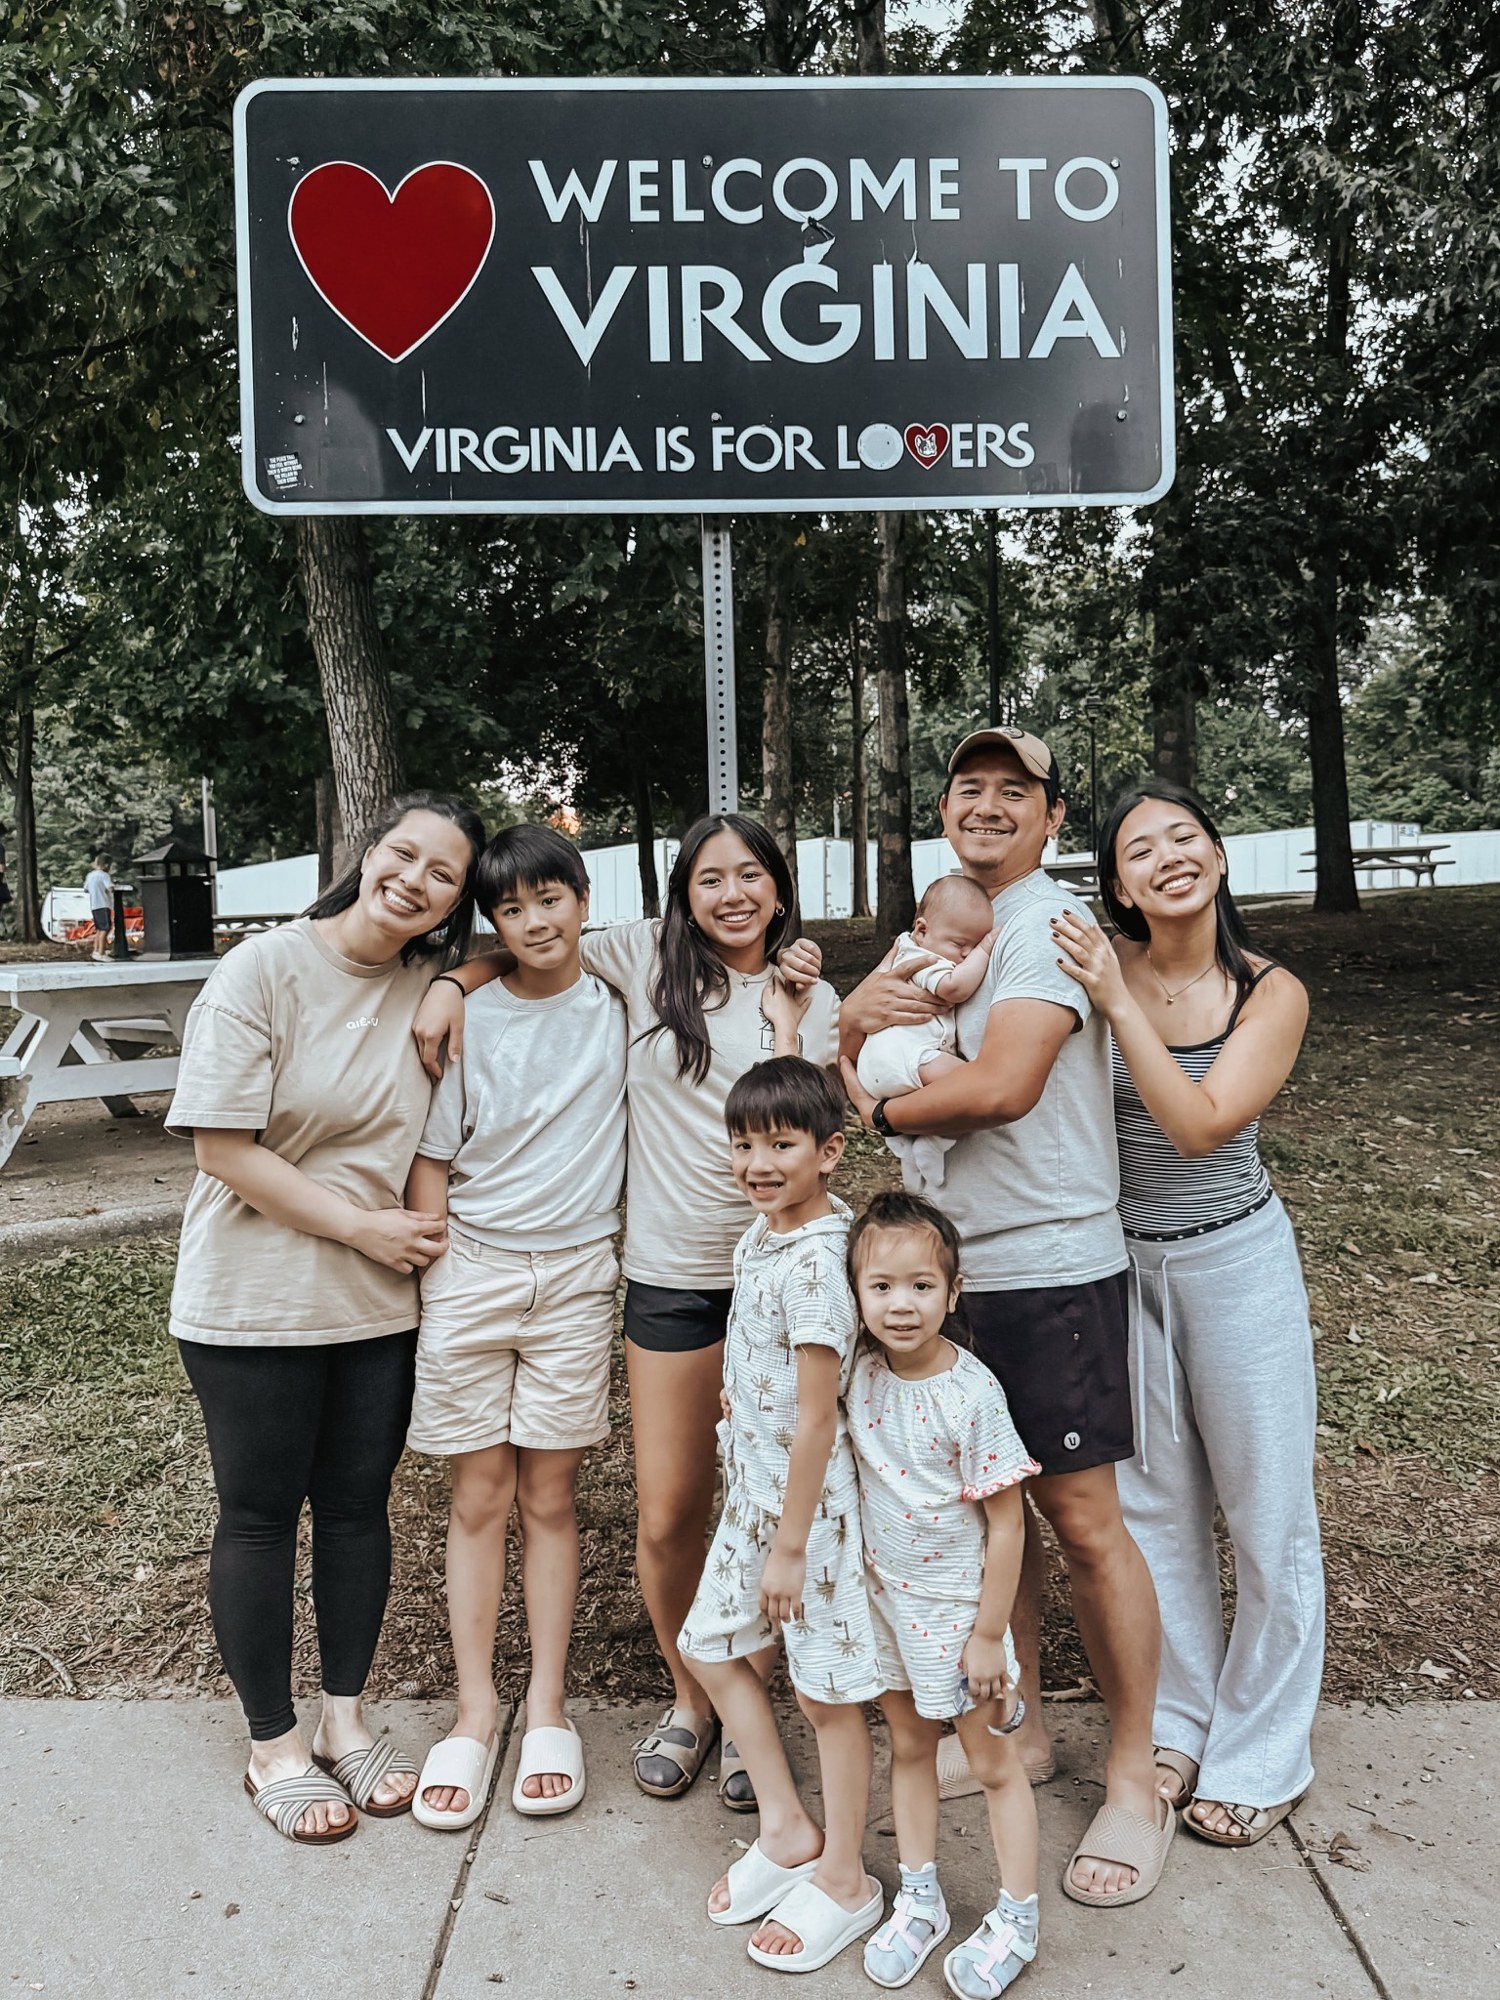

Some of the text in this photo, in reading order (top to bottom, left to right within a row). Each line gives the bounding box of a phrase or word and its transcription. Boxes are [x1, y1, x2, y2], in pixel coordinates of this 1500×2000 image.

[528, 157, 1119, 224] WELCOME TO
[530, 261, 1121, 367] VIRGINIA
[386, 422, 1036, 473] VIRGINIA IS FOR LOERS
